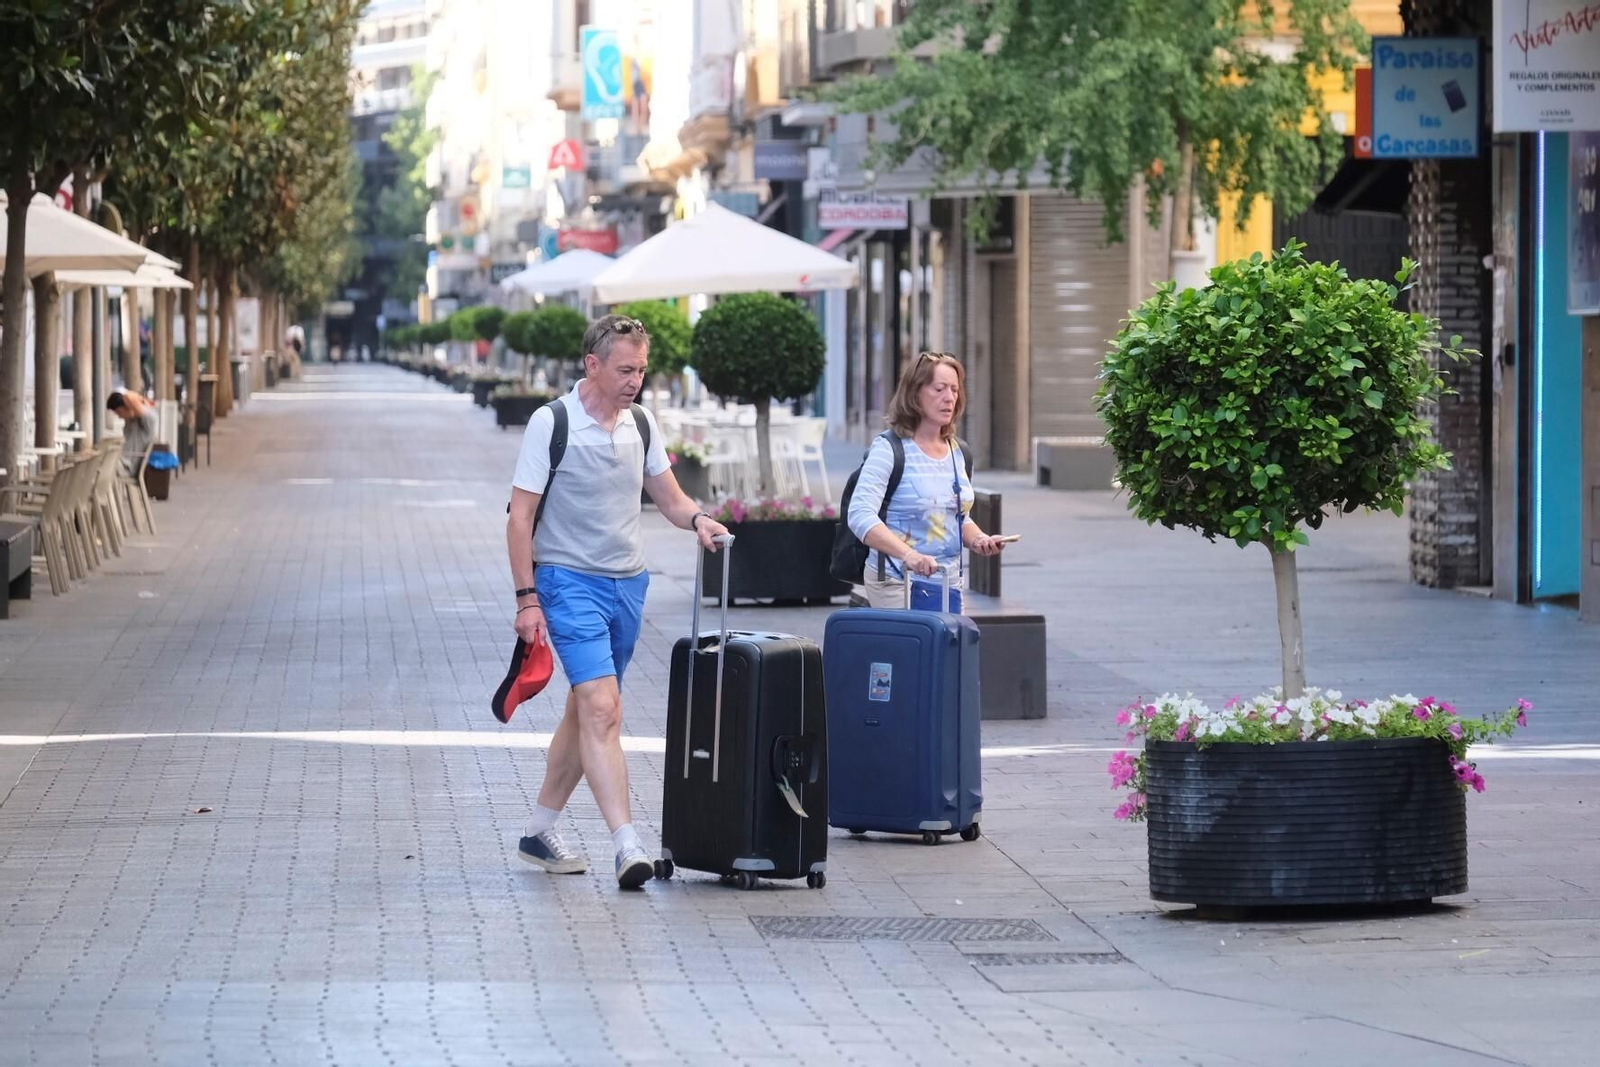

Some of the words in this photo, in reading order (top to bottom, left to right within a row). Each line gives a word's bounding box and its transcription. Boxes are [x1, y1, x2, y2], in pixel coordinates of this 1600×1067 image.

[1378, 44, 1474, 69] Paraiso
[1510, 71, 1549, 80] REGALOS
[1395, 83, 1416, 101] de
[1517, 84, 1523, 92] Y
[1525, 83, 1595, 92] COMPLEMENTOS
[1420, 114, 1442, 127] las
[1377, 132, 1472, 154] Carcasas
